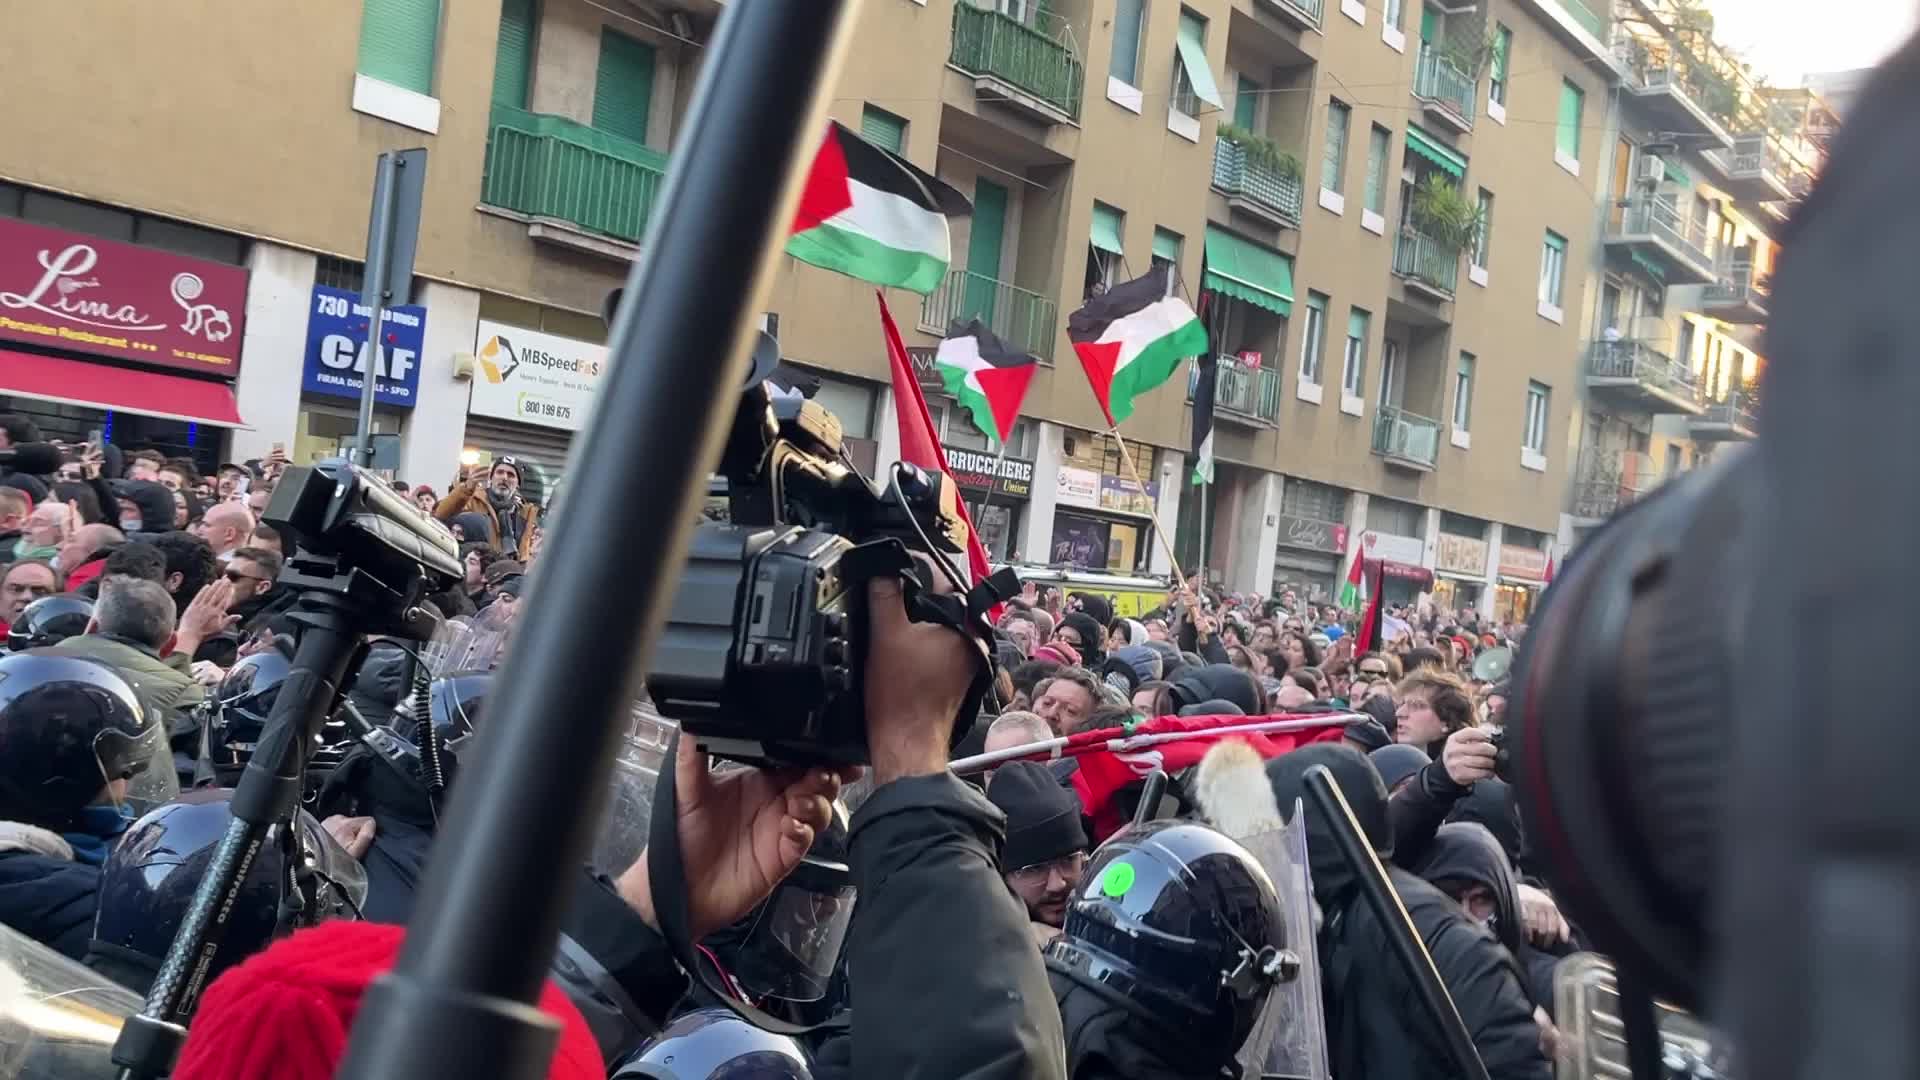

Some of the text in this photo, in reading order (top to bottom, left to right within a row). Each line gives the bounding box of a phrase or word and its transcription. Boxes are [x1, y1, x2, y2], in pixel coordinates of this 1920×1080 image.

[0, 244, 167, 331] Lima
[317, 293, 349, 318] 730
[320, 333, 416, 381] CAF
[521, 347, 601, 378] MBSpeedFaS
[316, 373, 346, 386] FIRMA
[346, 378, 385, 393] DIGLE
[390, 386, 410, 397] SPID
[525, 400, 540, 414] 800
[541, 403, 555, 416] 199
[216, 839, 261, 924] Manfrotto
